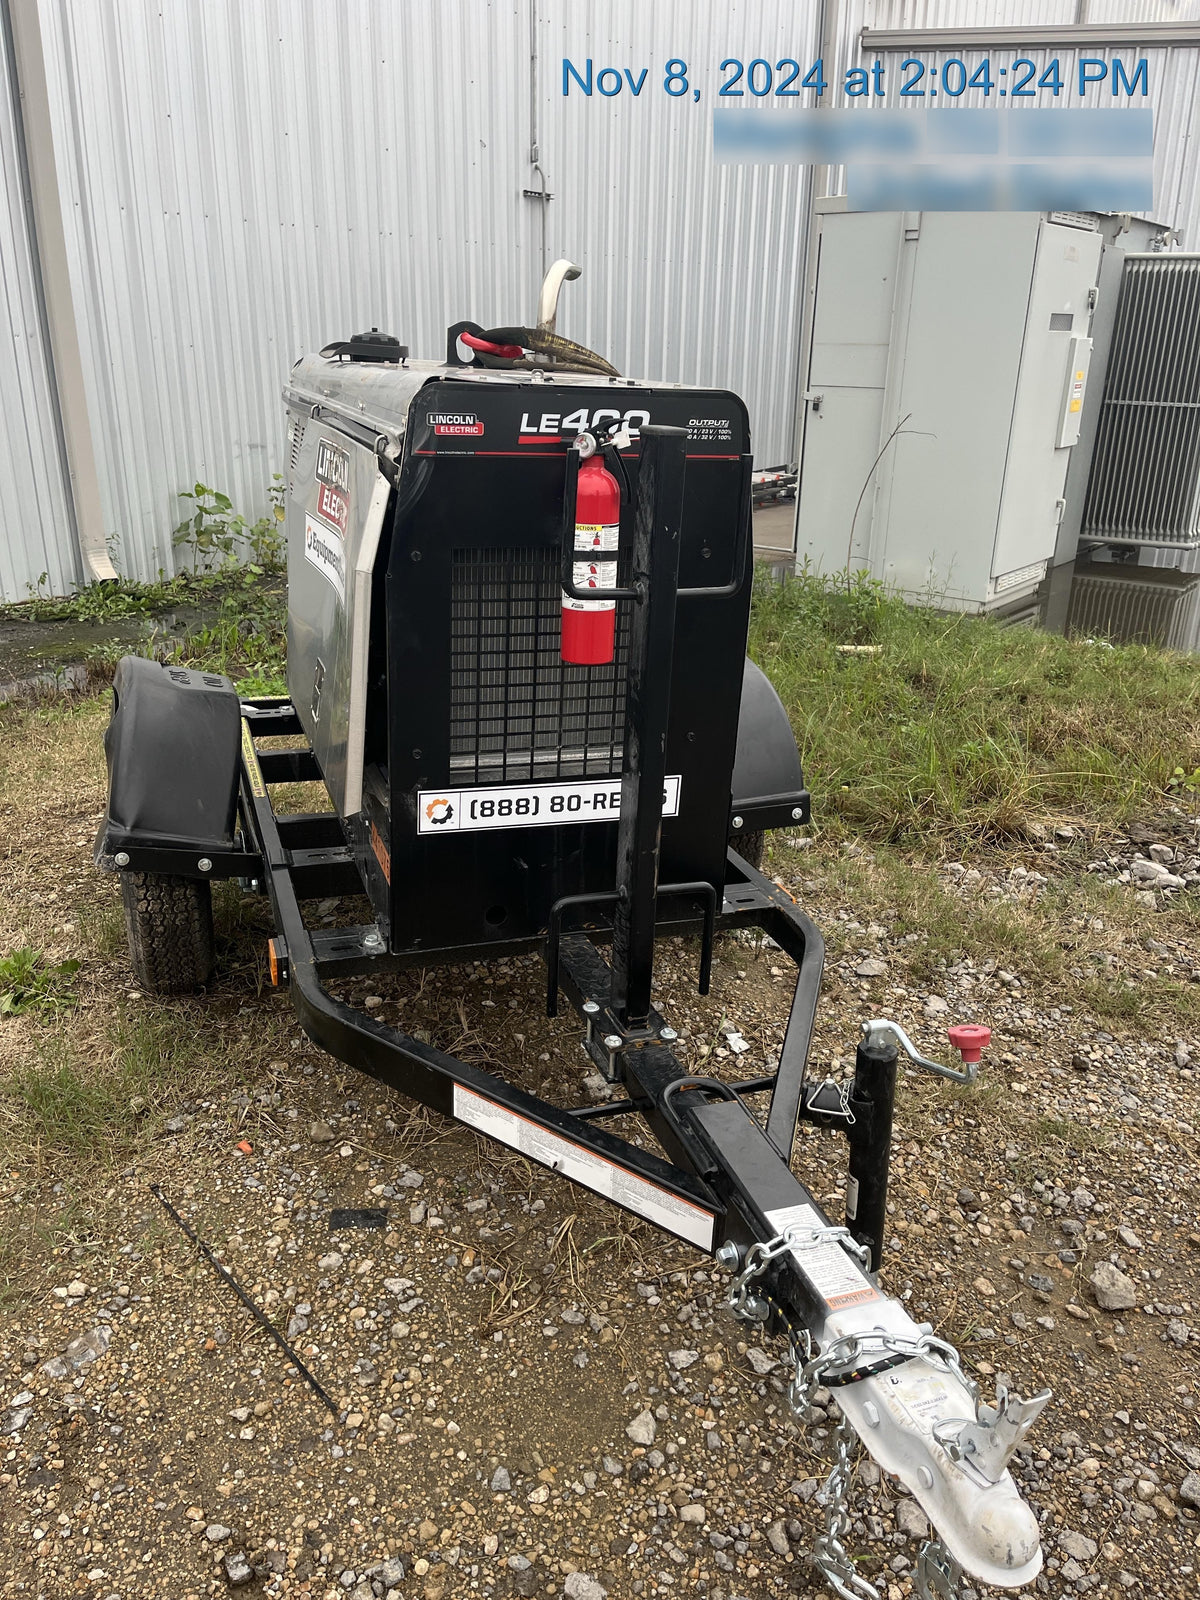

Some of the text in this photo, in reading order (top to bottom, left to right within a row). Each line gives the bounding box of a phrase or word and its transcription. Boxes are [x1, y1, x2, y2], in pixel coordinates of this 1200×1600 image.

[429, 414, 474, 425] LINCOLN
[519, 408, 650, 434] LE400
[440, 425, 479, 434] ELECTRIC
[469, 795, 540, 820] (888)
